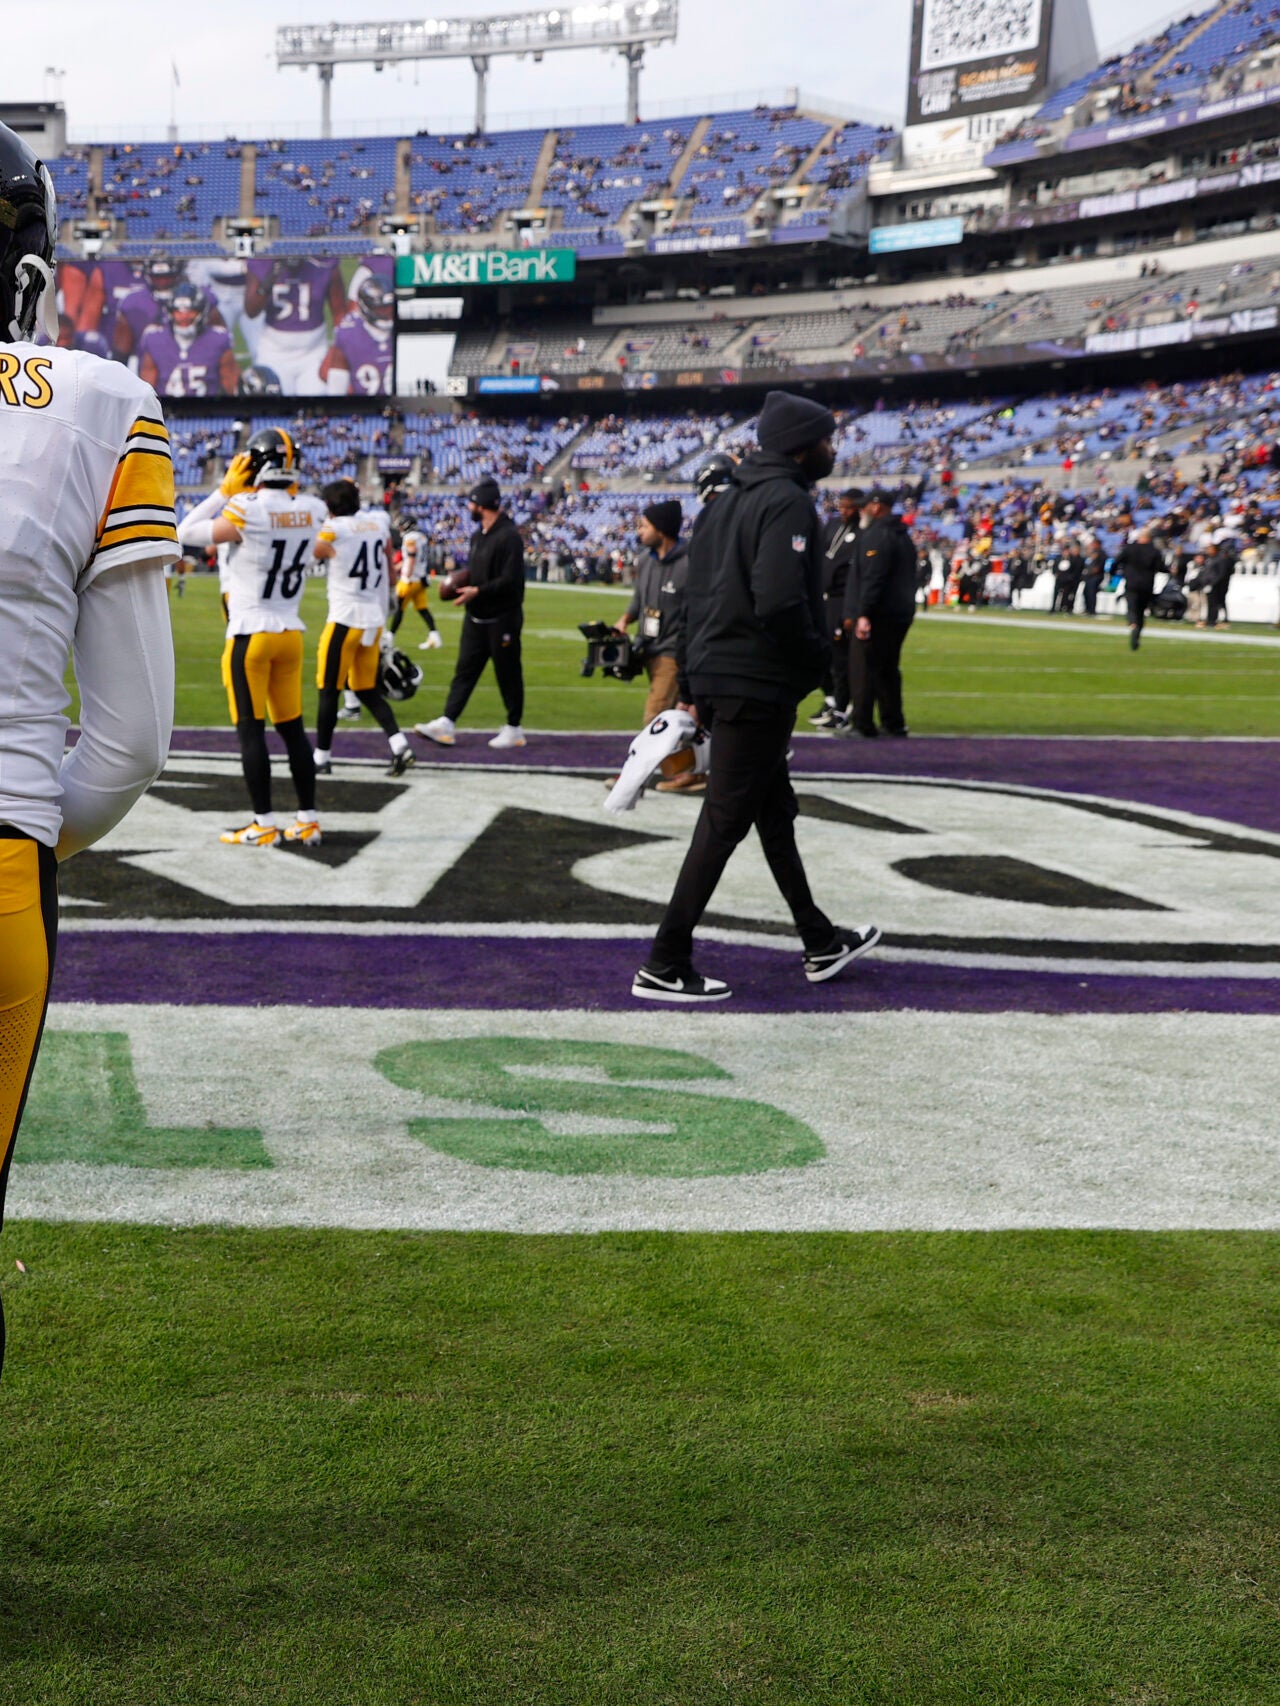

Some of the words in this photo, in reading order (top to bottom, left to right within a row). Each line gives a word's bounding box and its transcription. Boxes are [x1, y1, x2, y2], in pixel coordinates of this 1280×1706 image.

[412, 252, 486, 285] M&T
[487, 250, 557, 282] Bank
[272, 283, 310, 321] 51
[165, 365, 207, 397] 45
[262, 538, 310, 599] 16
[348, 539, 383, 590] 49
